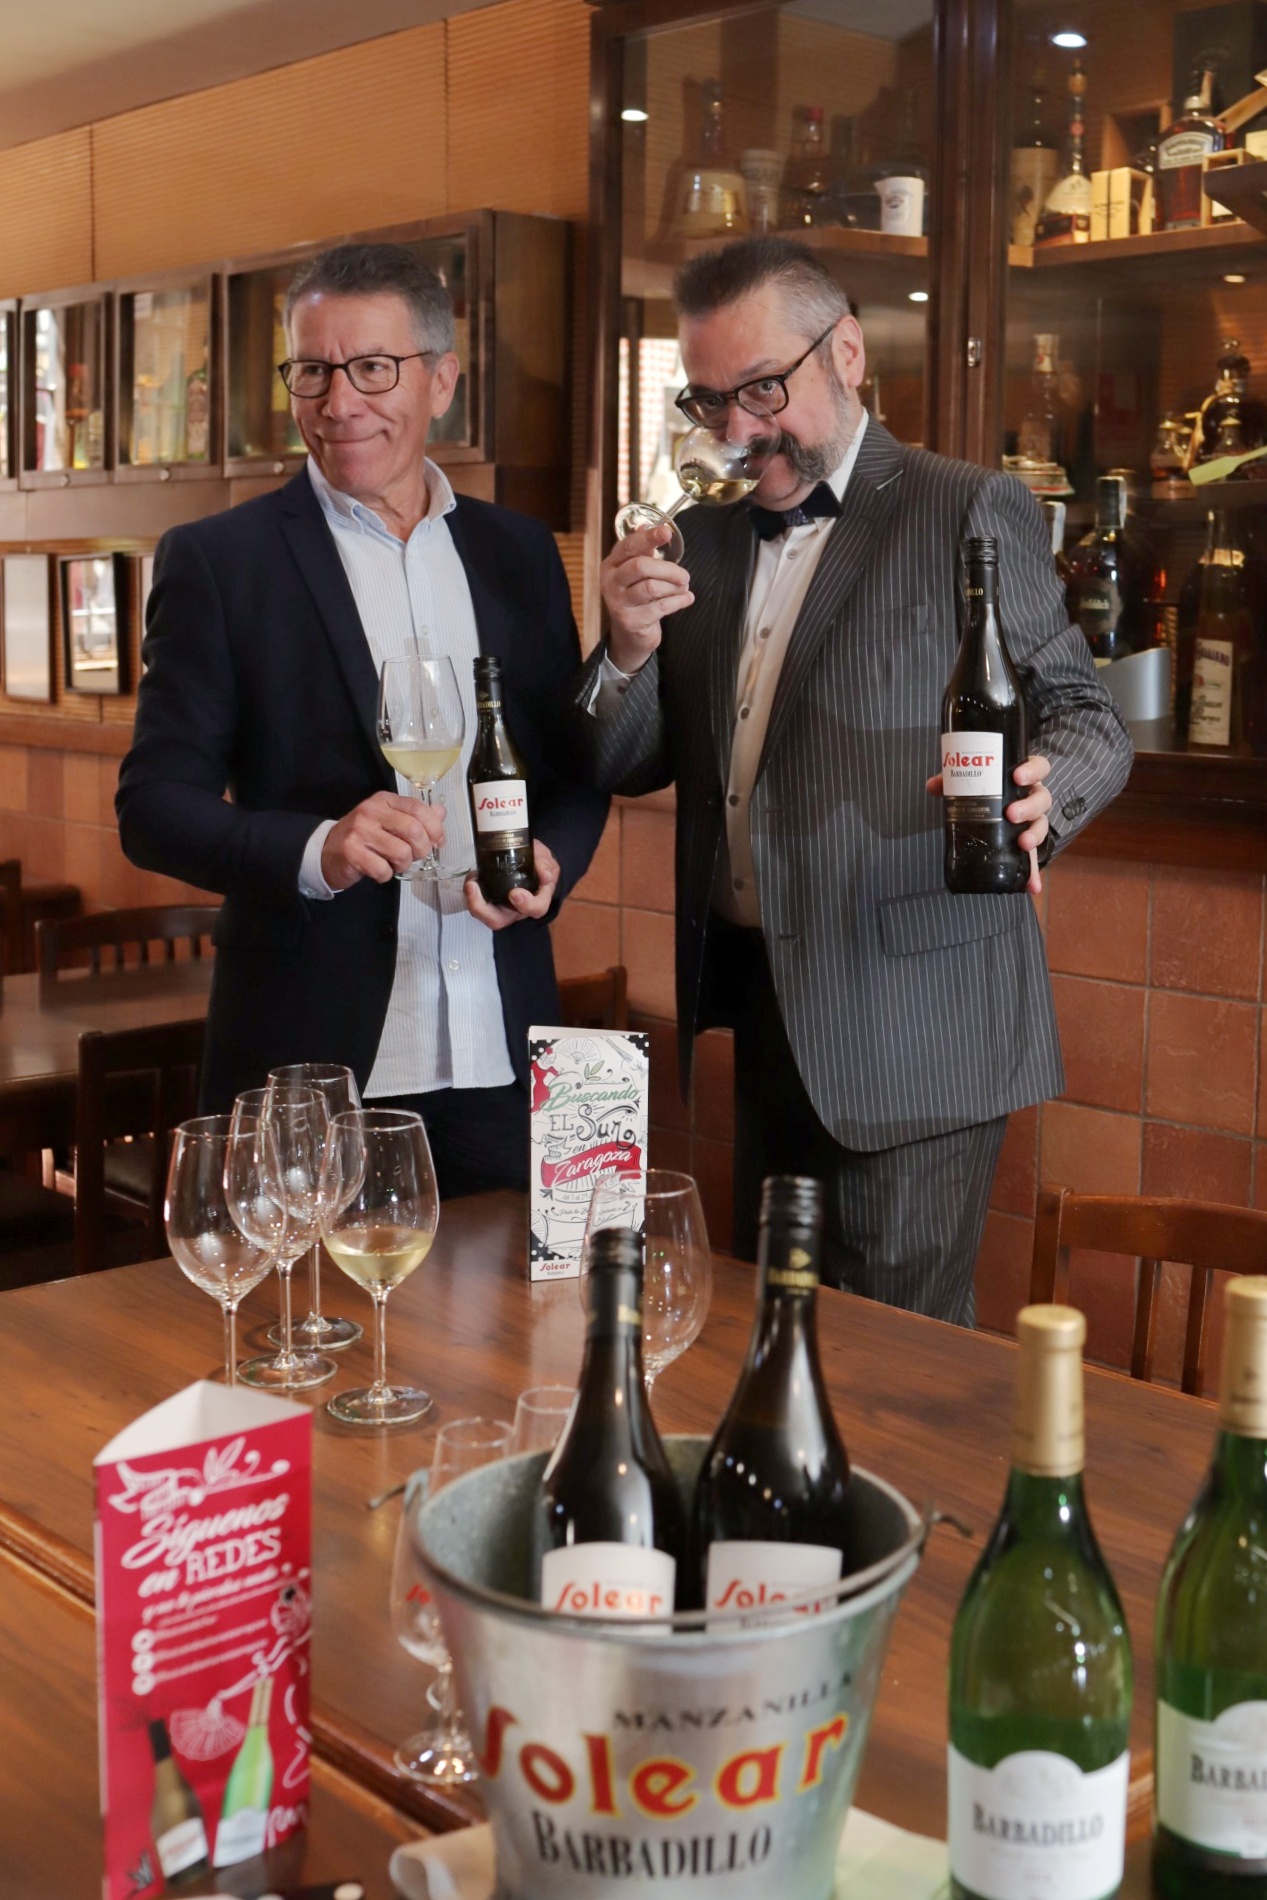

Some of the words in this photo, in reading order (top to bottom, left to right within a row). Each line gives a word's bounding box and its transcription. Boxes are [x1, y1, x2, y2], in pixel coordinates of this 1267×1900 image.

[943, 752, 994, 768] Solear
[478, 797, 524, 811] Solear
[541, 1082, 640, 1112] Buscando
[549, 1114, 574, 1131] EL
[576, 1103, 636, 1150] Sur
[572, 1144, 586, 1154] en
[551, 1151, 632, 1188] Zaragoza
[540, 1263, 571, 1271] Solear
[138, 1567, 180, 1598] en
[186, 1526, 282, 1585] REDES
[555, 1582, 662, 1614] Solear
[612, 1673, 853, 1732] MANZANILLA
[479, 1704, 850, 1822] Solear
[972, 1803, 1105, 1847] BARBADILLO
[530, 1808, 772, 1881] BARBADILLO
